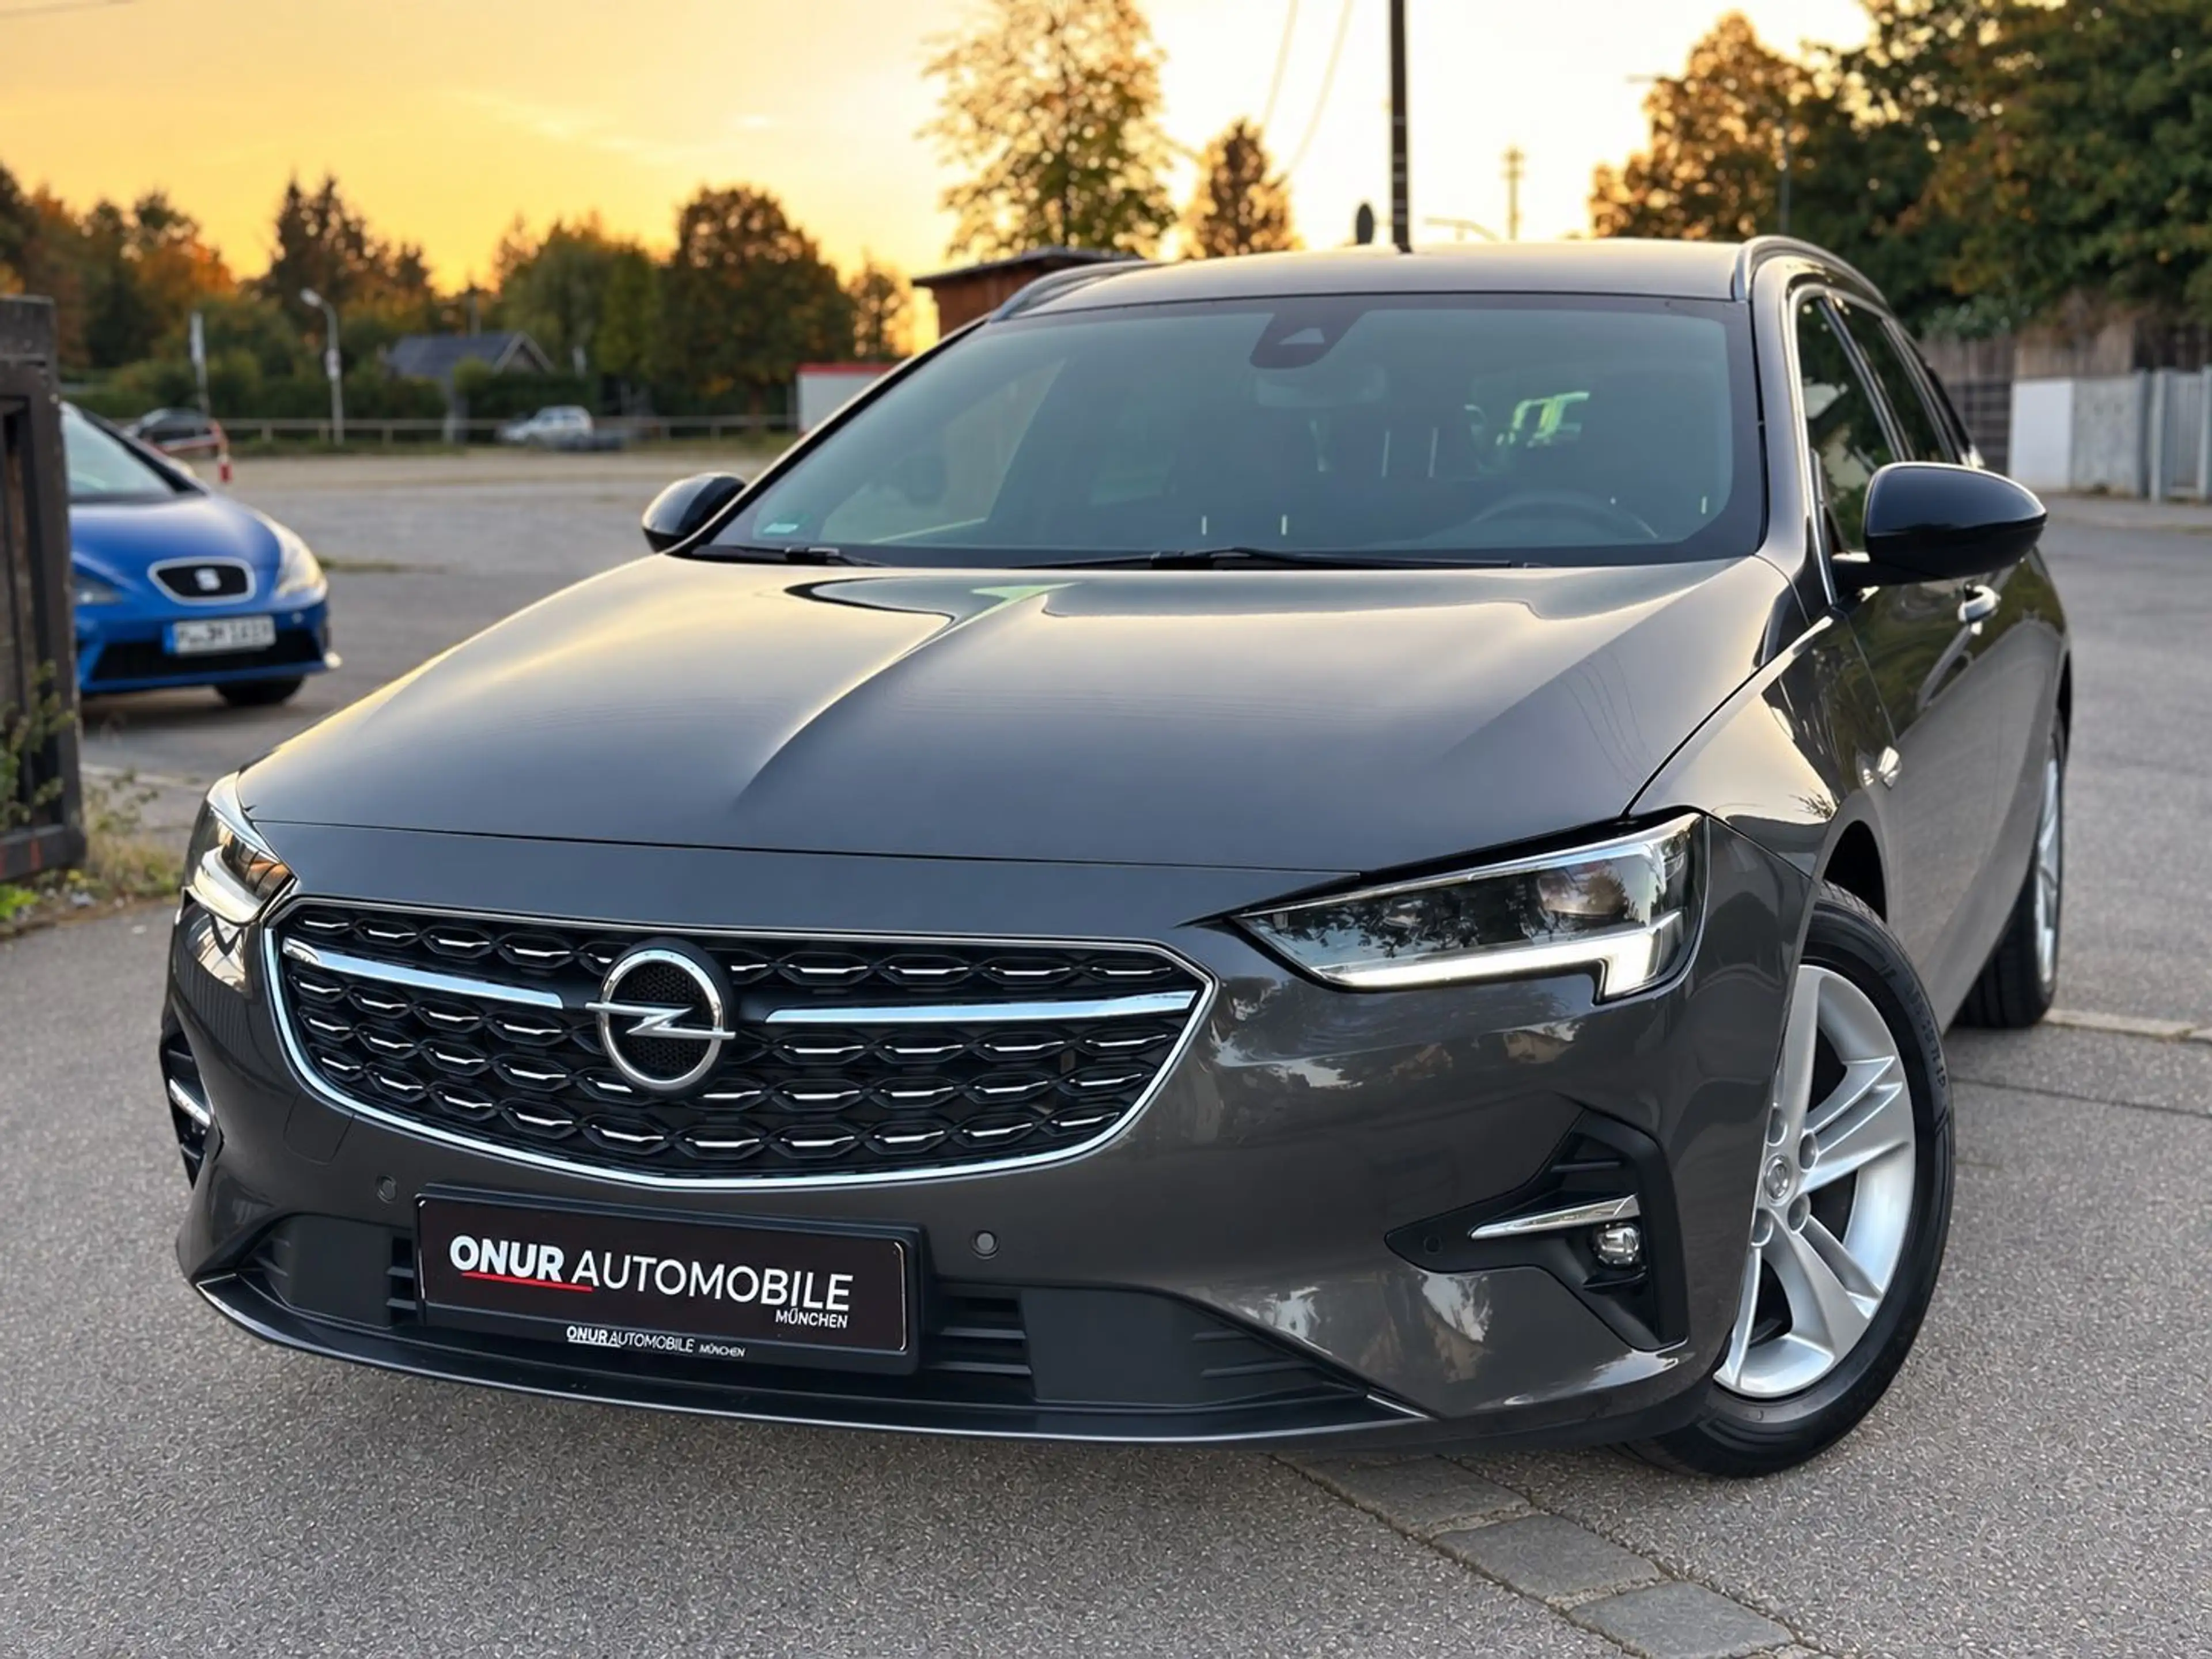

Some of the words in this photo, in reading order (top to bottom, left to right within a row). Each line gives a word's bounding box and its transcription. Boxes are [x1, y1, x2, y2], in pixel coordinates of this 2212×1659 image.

[450, 1235, 565, 1283] ONUR
[571, 1250, 854, 1312] AUTOMOBILE
[775, 1307, 849, 1328] MÜNCHEN
[566, 1325, 608, 1343] ONUR
[609, 1331, 695, 1353] AUTOMOBILE
